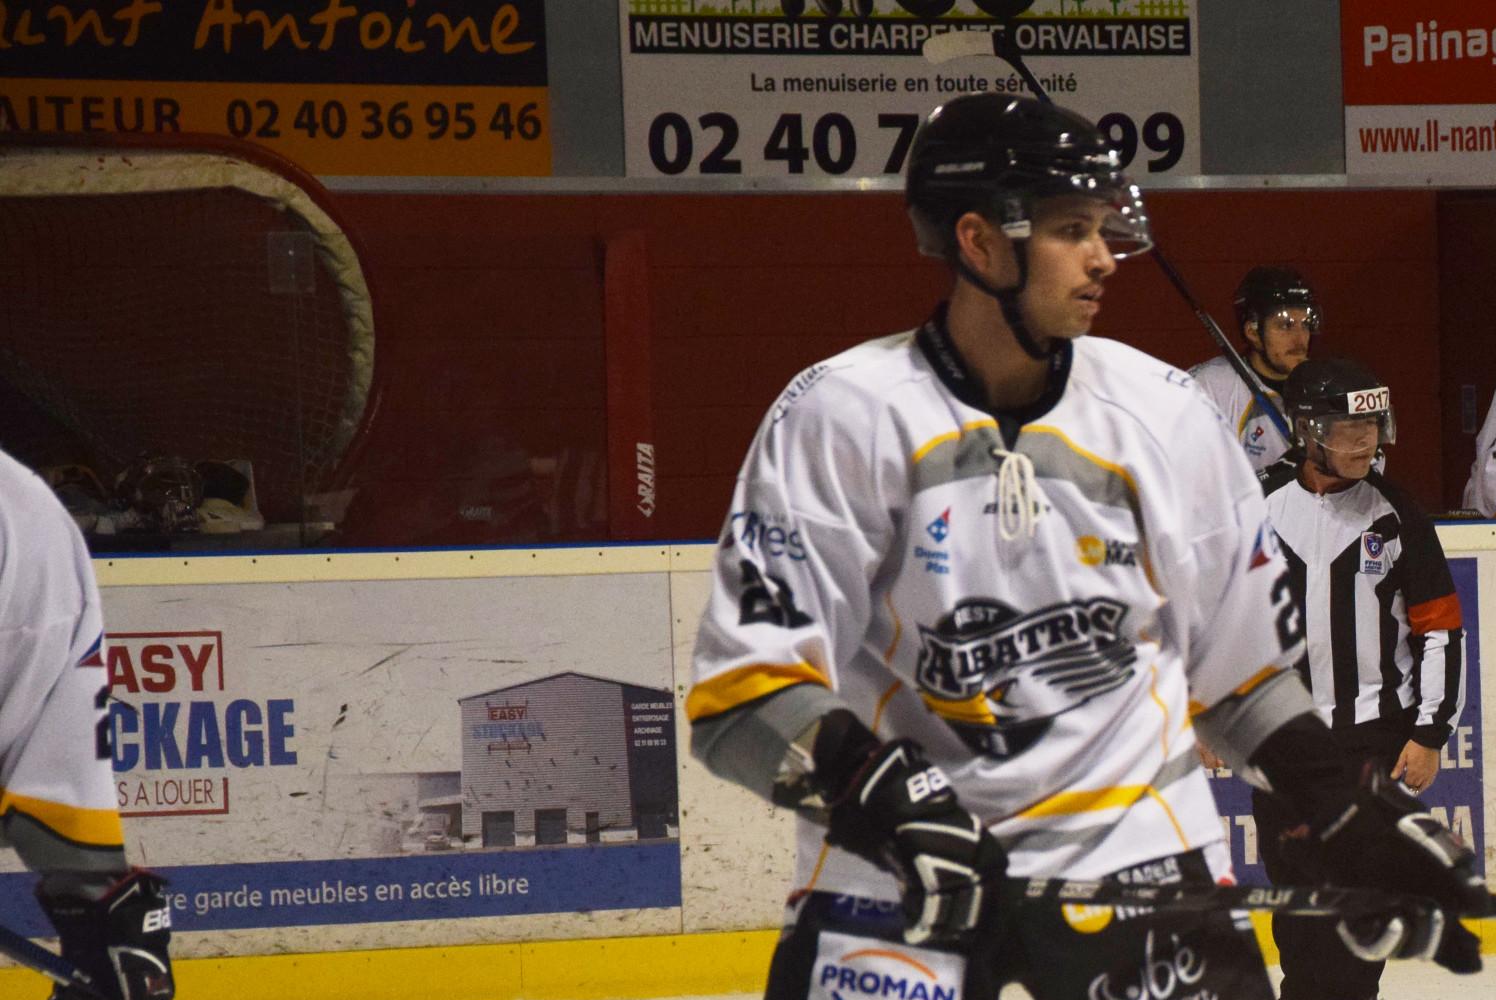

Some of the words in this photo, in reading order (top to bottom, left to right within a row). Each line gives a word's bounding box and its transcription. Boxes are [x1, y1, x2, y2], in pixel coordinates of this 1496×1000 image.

[0, 0, 162, 48] int
[194, 0, 535, 55] Antoine
[634, 22, 823, 50] MENUISERIE
[1018, 25, 1185, 51] ORVALTAISE
[750, 74, 776, 92] La
[783, 72, 897, 92] menuiserie
[904, 78, 930, 92] en
[935, 74, 989, 92] toute
[995, 73, 1077, 92] sérnité
[227, 99, 280, 140] 02
[294, 100, 348, 140] 40
[361, 100, 413, 140] 36
[425, 100, 477, 140] 95
[489, 101, 542, 141] 46
[648, 112, 742, 175] 02
[763, 112, 857, 175] 40
[1354, 391, 1389, 412] 2017
[107, 643, 214, 693] ASY
[110, 698, 297, 773] CKAGE
[490, 708, 525, 721] EASY
[135, 780, 148, 804] A
[154, 778, 214, 804] LOUER
[194, 883, 263, 916] garde
[270, 879, 369, 906] meubles
[375, 882, 403, 902] en
[410, 870, 472, 899] accès
[478, 873, 529, 897] libre
